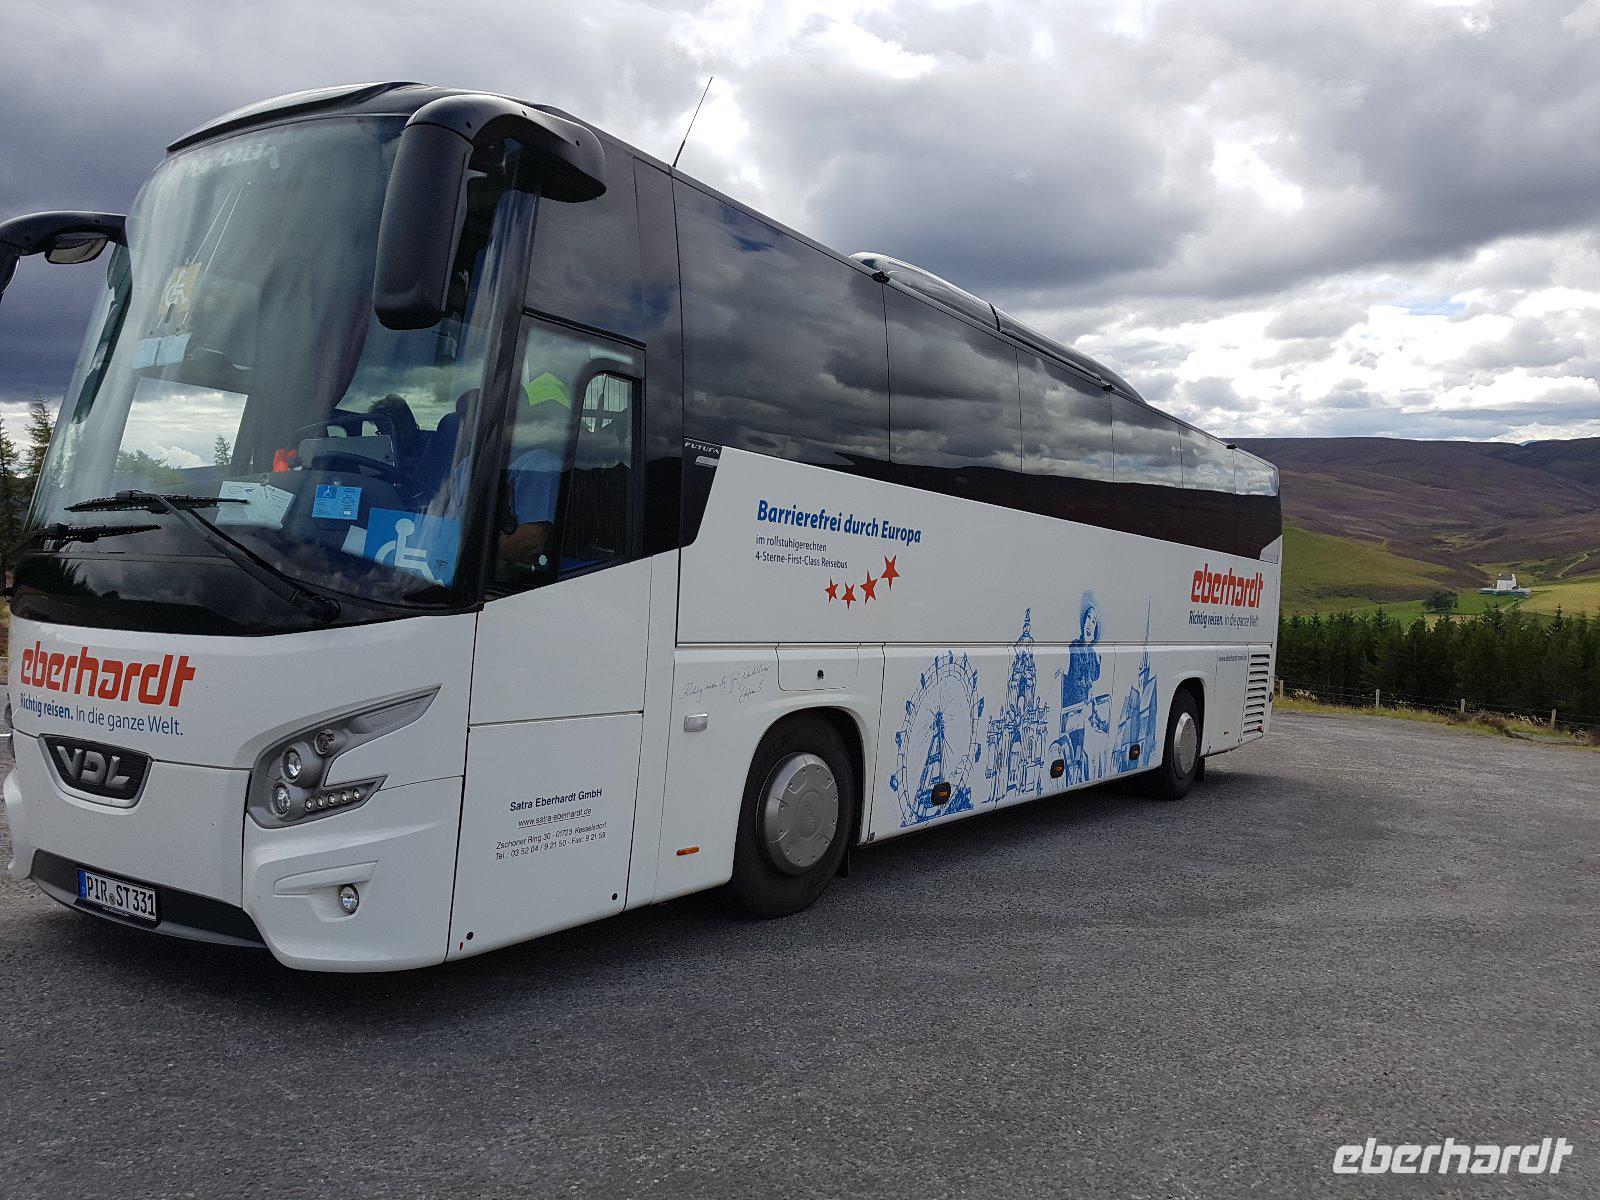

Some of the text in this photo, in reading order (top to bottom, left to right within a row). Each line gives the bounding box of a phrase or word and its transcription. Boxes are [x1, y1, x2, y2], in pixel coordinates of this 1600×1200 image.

[684, 441, 720, 454] FUTURA
[757, 499, 922, 546] Barrierefrei durch Europa
[755, 534, 827, 552] im rollstuhlgerechten
[755, 550, 848, 570] 4-Sterne-First-Class Reisebus
[1190, 563, 1264, 608] eberhardt
[1188, 610, 1207, 628] Richtig
[20, 640, 196, 707] eberhardt
[20, 692, 183, 736] Richtig reisen. In die ganze Welt.
[56, 745, 131, 790] VDL
[509, 788, 603, 812] Satra Eberhardt GmbH
[510, 849, 520, 858] 03
[530, 844, 539, 853] 04
[590, 833, 597, 841] 21
[527, 835, 542, 845] Ring
[542, 832, 552, 841] 30
[86, 875, 108, 903] PIR
